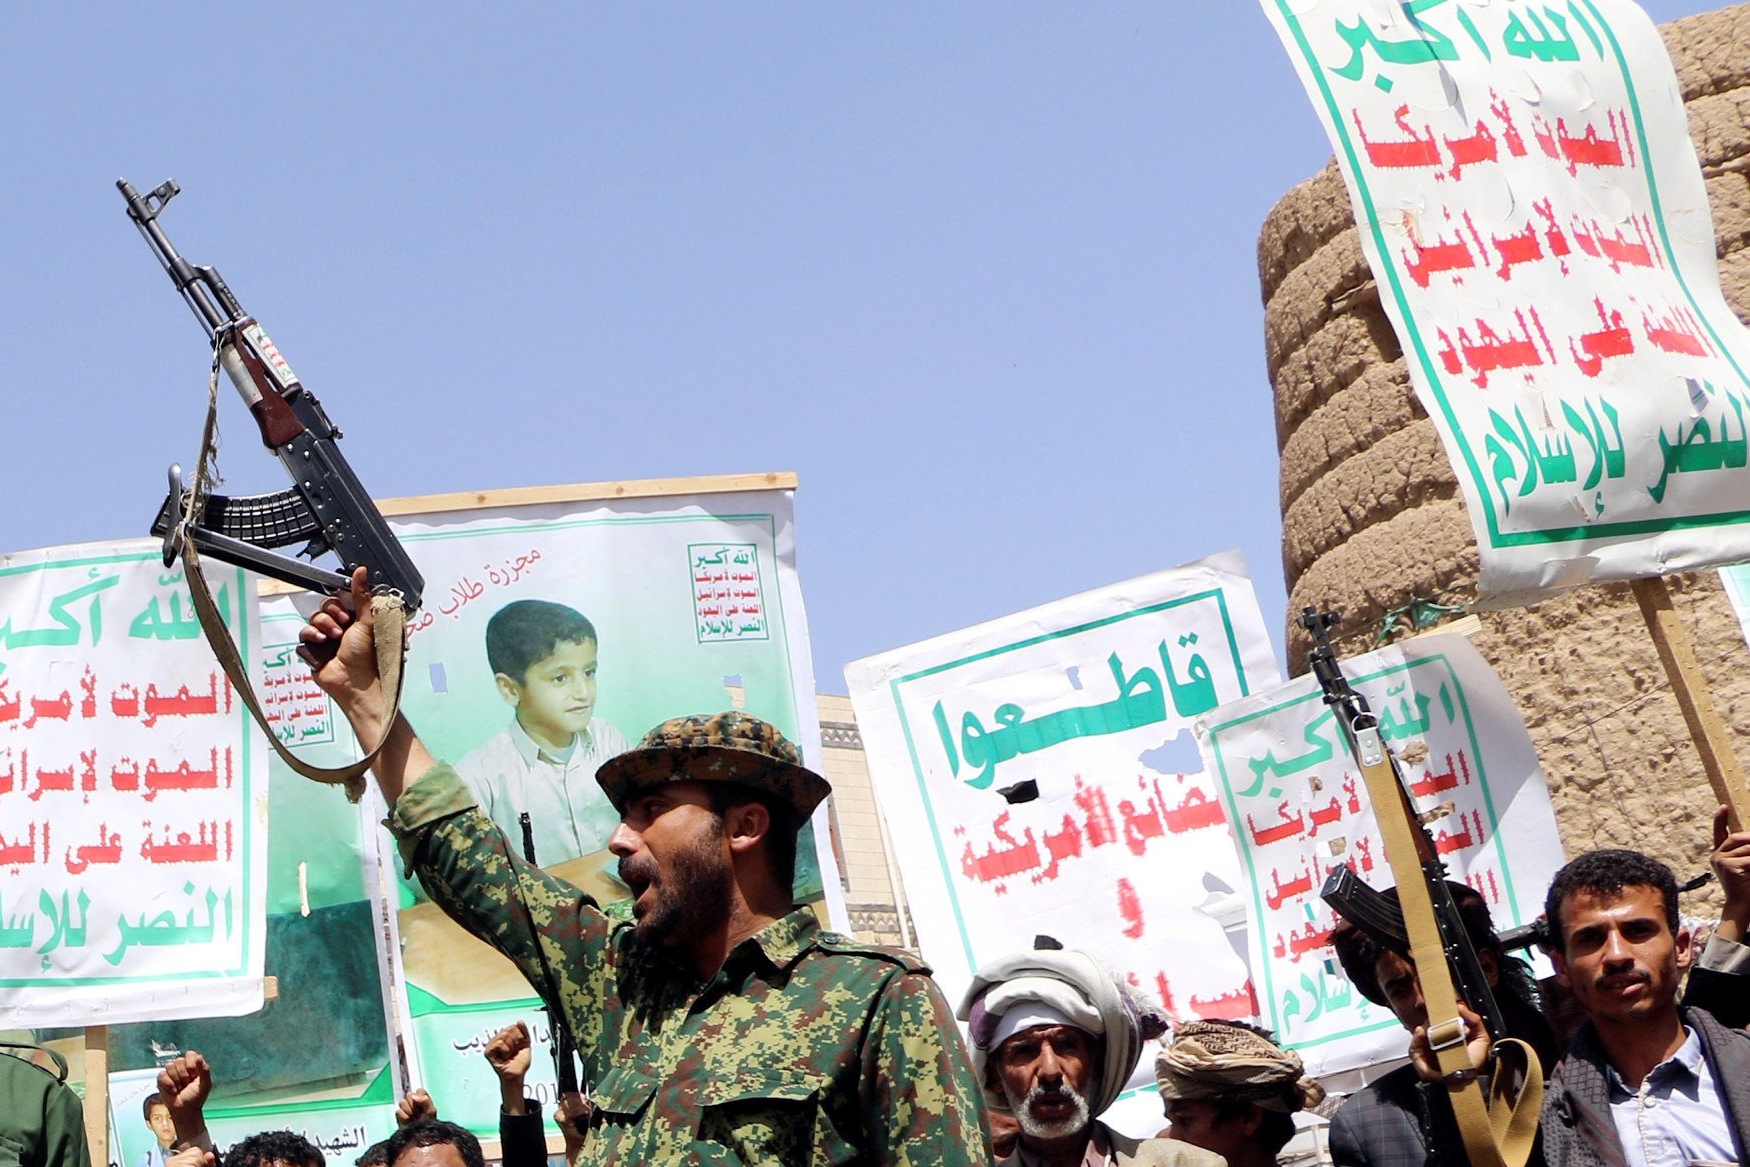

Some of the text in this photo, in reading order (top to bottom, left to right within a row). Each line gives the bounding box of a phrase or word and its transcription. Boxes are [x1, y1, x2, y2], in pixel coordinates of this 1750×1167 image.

[1352, 84, 1635, 183] الموت لأمريكا
[1570, 211, 1664, 274] الموت
[1436, 303, 1557, 389] اليهود
[1567, 292, 1635, 378] على
[1484, 394, 1625, 519] للإسلام
[438, 549, 541, 620] مجزرة طلاب
[693, 547, 755, 570] الله أكبر
[732, 571, 757, 583] الموت
[129, 563, 233, 642] الله
[733, 587, 760, 600] الموت
[700, 617, 765, 639] النصر للإسلام
[110, 667, 233, 728] الموت
[932, 631, 1220, 790] قاطعوا
[299, 719, 330, 741] النصر
[110, 744, 233, 801] الموت
[1247, 772, 1361, 847] لأمريكا
[65, 820, 124, 876] على
[140, 819, 234, 865] اللعنة
[102, 880, 233, 967] النصر
